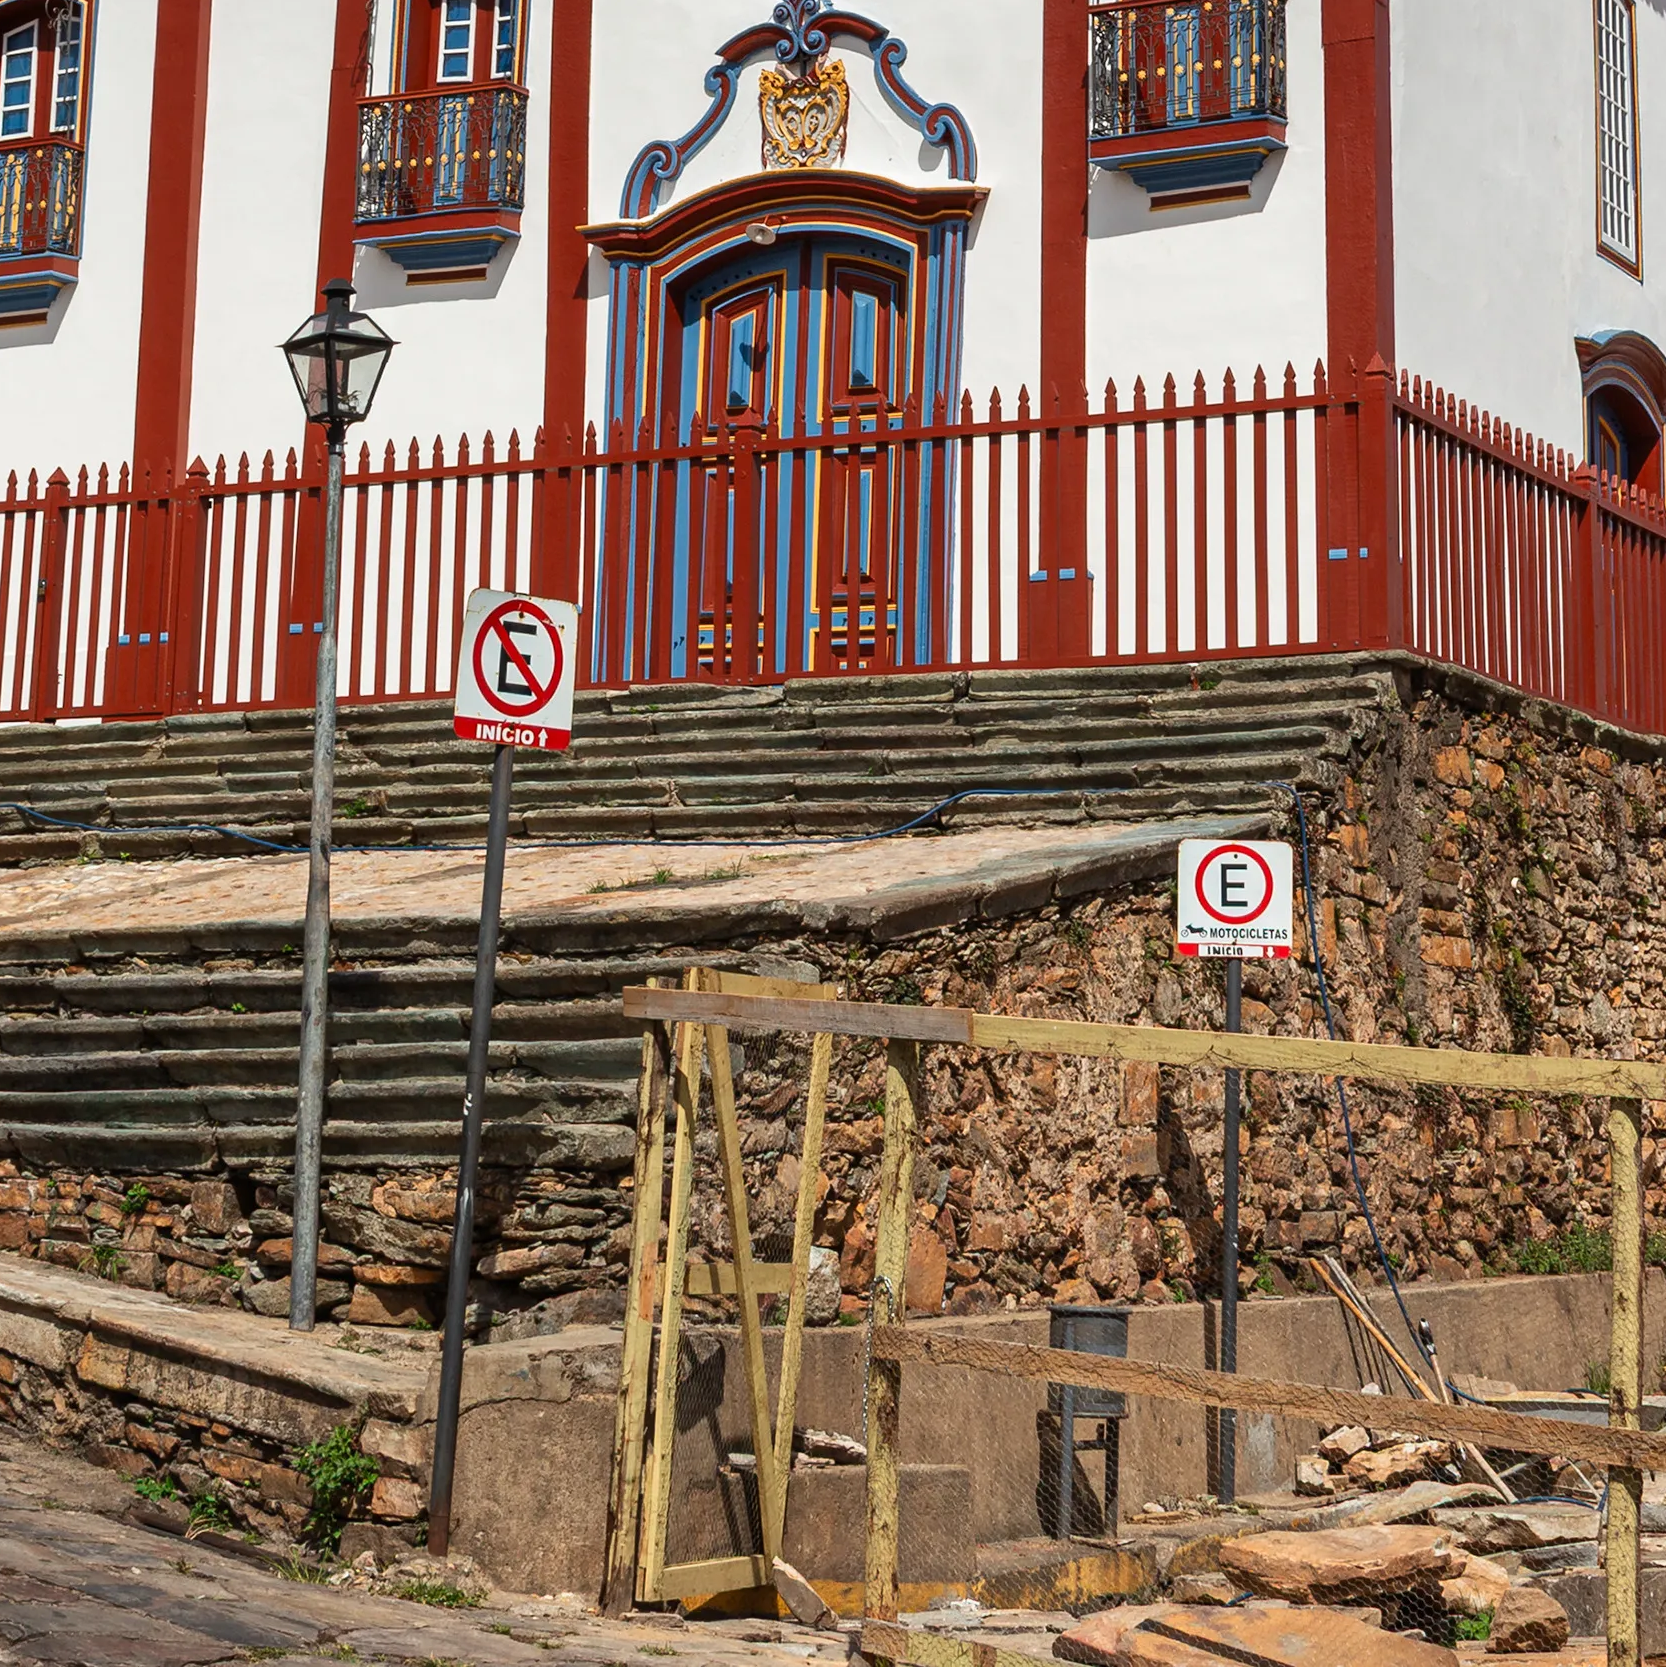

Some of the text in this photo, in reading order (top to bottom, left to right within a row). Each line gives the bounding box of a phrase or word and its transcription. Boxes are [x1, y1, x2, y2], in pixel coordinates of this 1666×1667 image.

[497, 620, 538, 697] E
[476, 722, 535, 746] INÍCIO
[1221, 863, 1248, 907] E
[1209, 927, 1288, 940] MOTOCICLETAS
